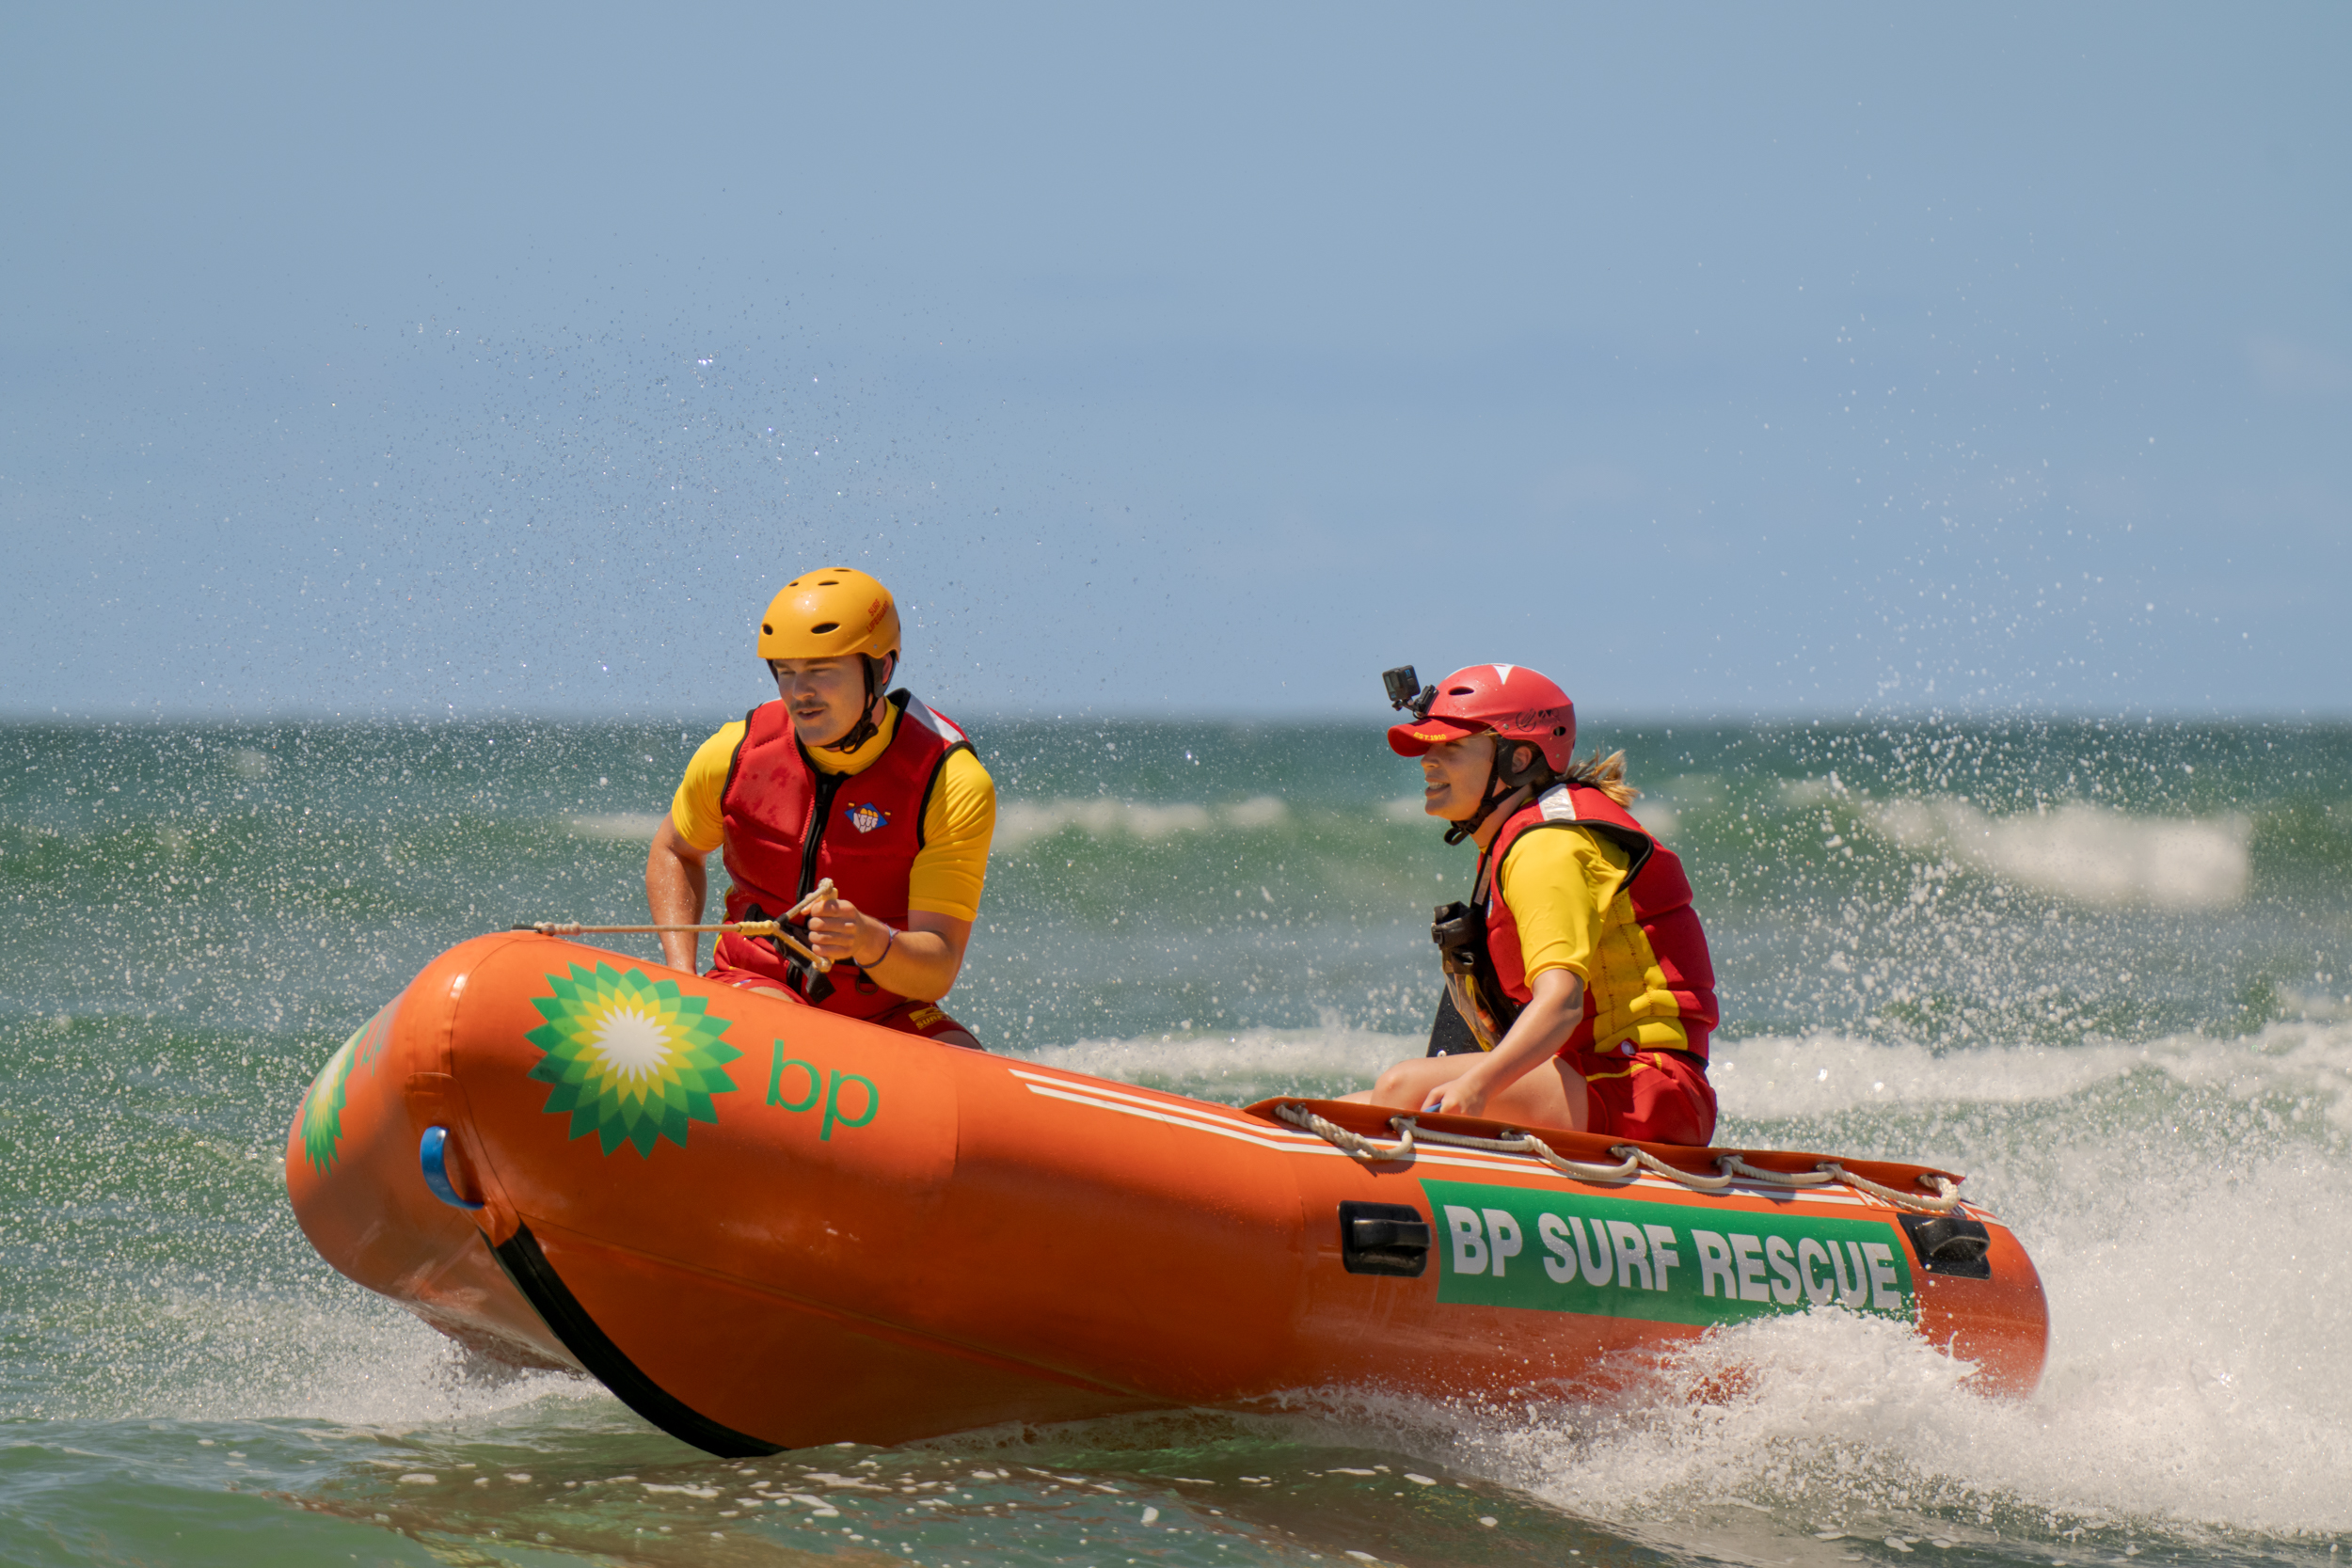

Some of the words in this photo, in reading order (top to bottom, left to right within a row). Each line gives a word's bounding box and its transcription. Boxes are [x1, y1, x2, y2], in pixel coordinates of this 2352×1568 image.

[765, 1038, 880, 1142] bp
[1443, 1204, 1522, 1277] BP
[1537, 1212, 1680, 1292] SURF
[1691, 1228, 1902, 1311] RESCUE
